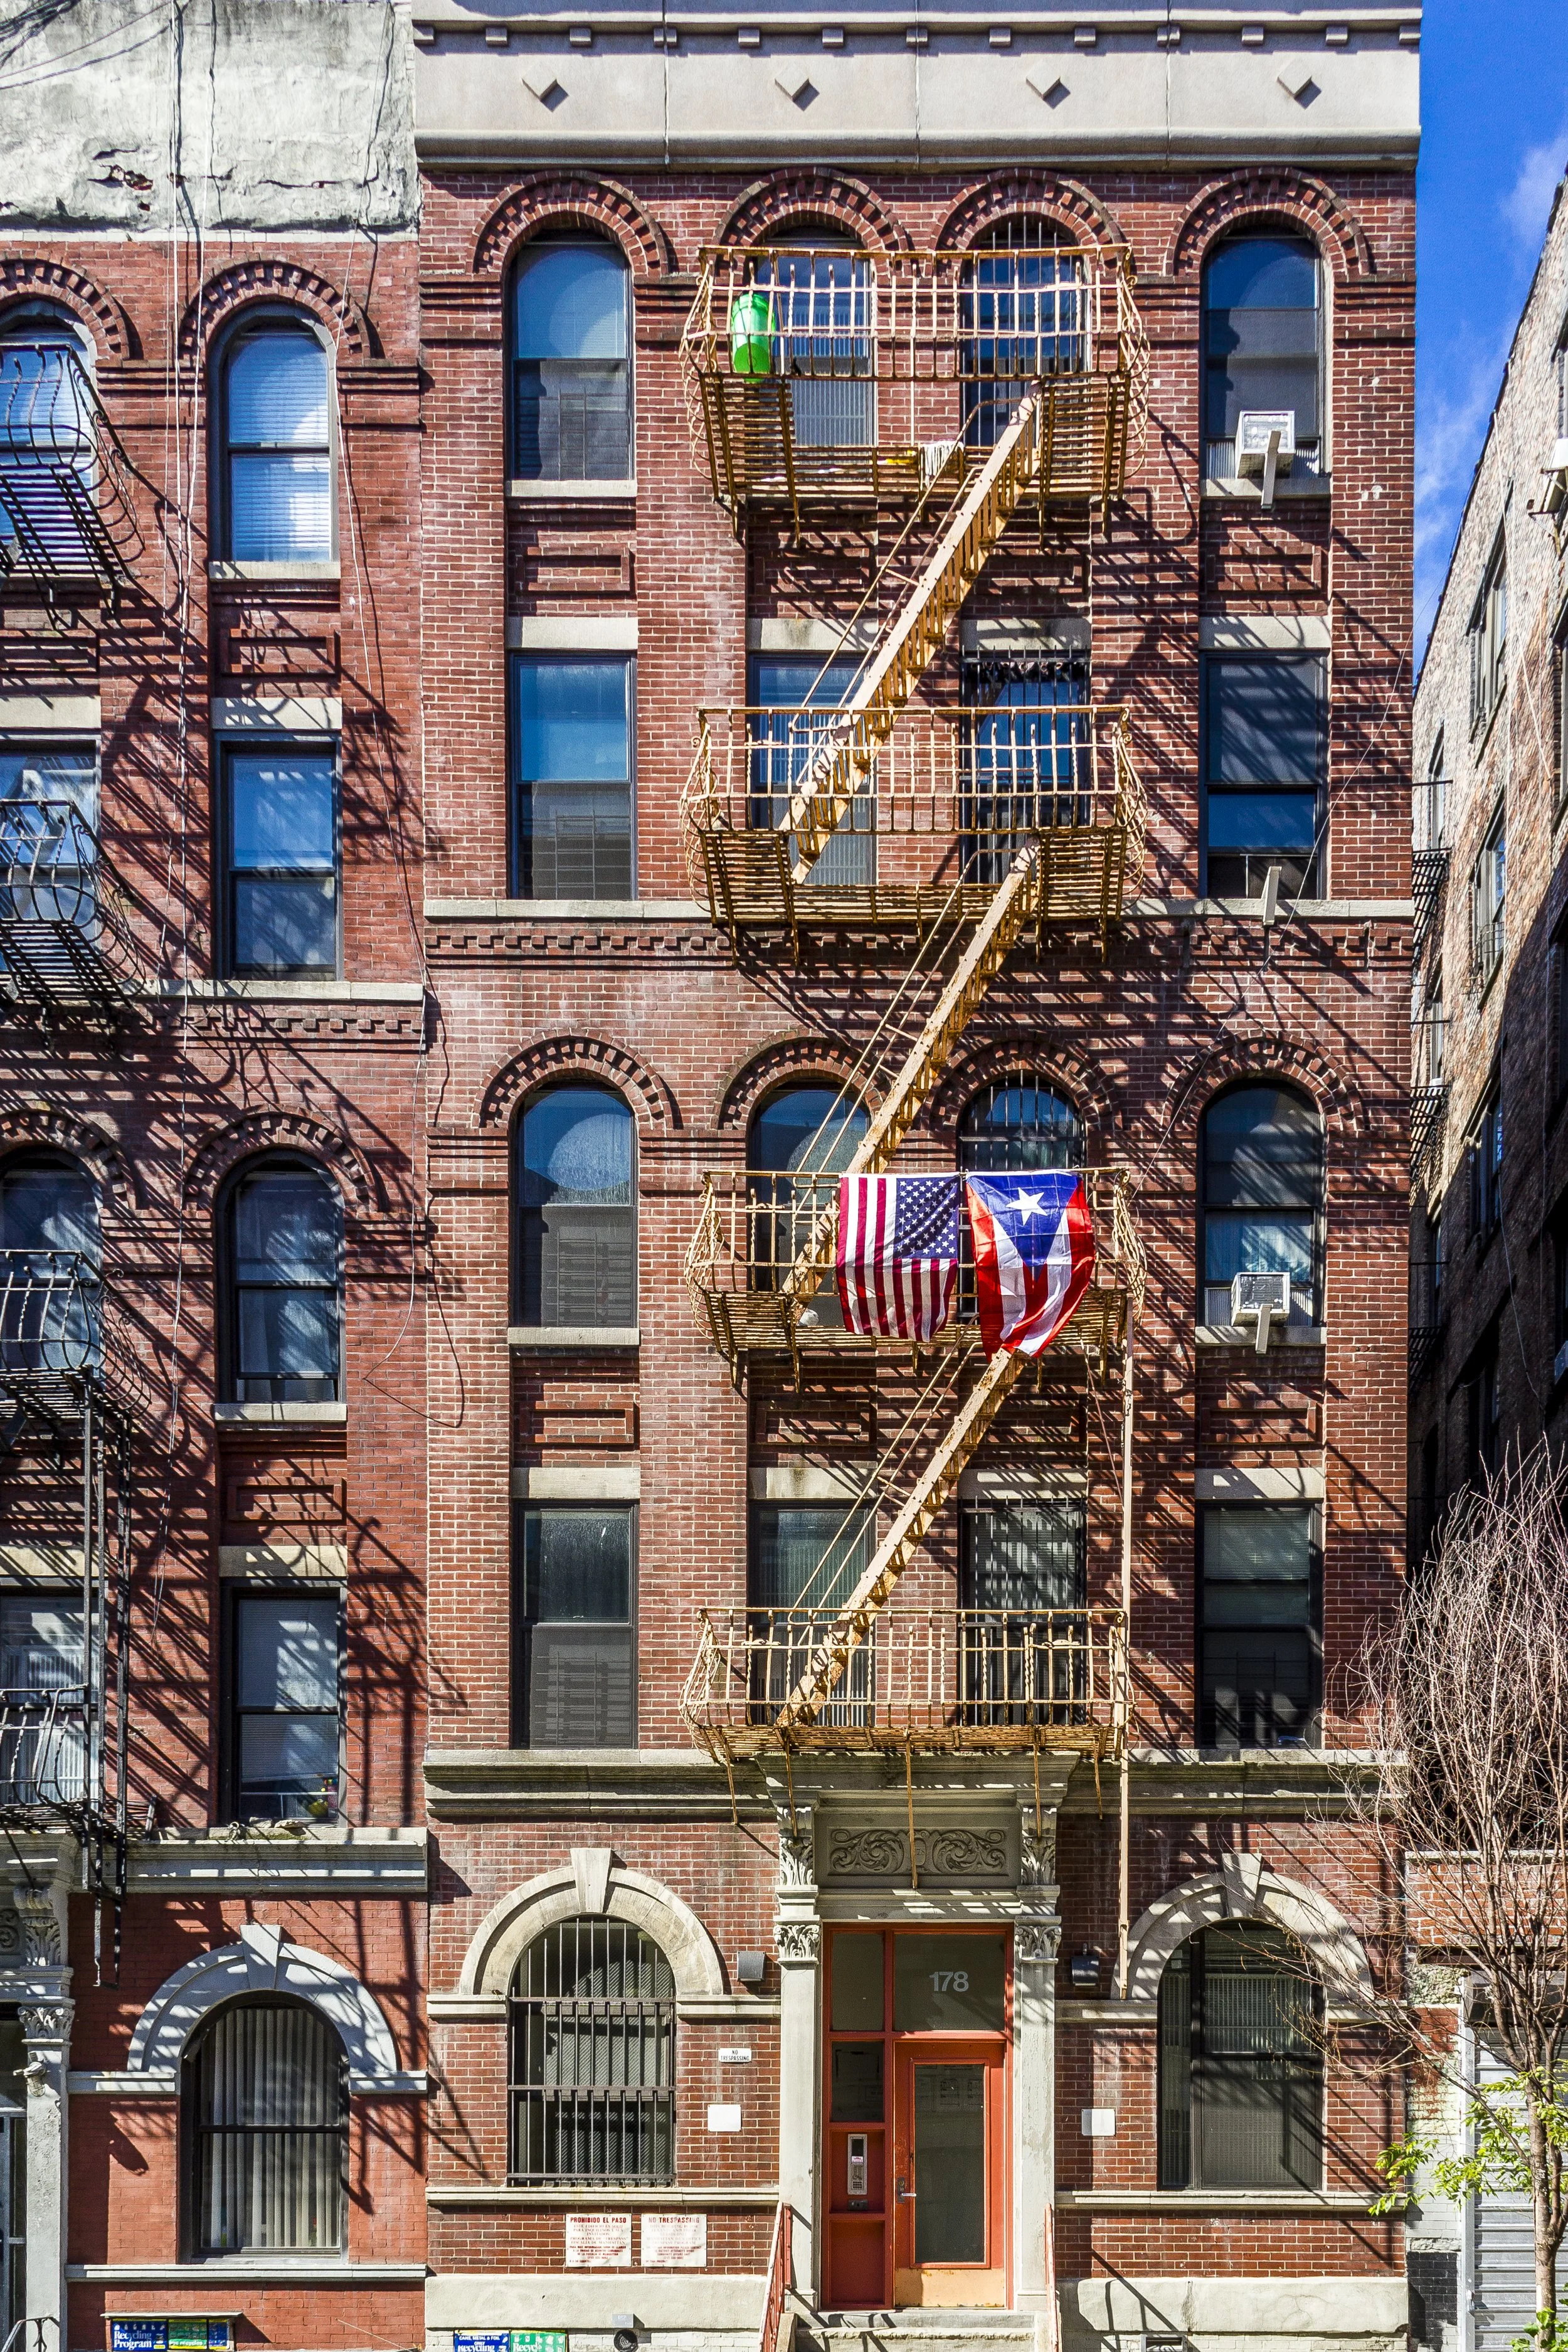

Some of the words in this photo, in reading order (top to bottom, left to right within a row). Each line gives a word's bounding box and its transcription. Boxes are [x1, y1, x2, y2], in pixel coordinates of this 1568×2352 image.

[930, 1971, 969, 1992] 178
[114, 2331, 152, 2341] Recycling
[114, 2339, 152, 2350] Program
